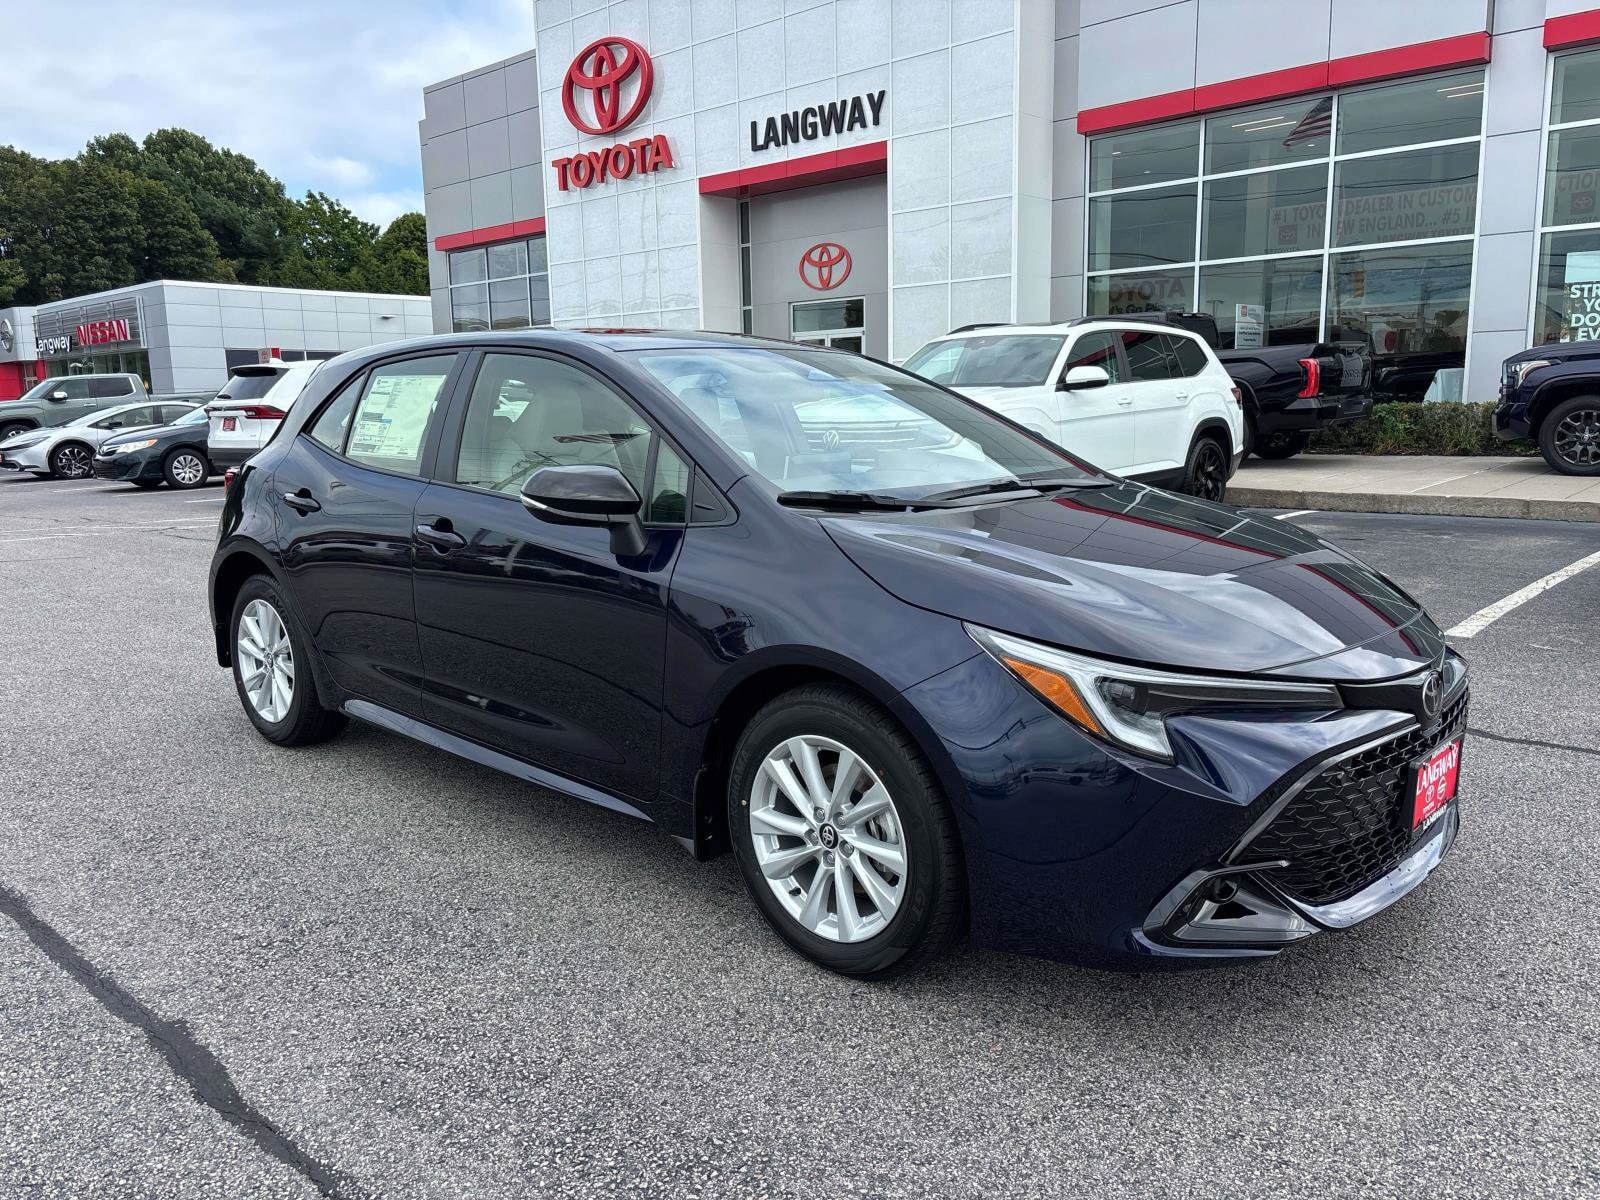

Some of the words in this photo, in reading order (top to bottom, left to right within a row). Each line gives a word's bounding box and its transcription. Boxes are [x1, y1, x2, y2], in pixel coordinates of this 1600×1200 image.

[750, 90, 886, 152] LANGWAY
[552, 135, 674, 191] TOYOTA
[1272, 208, 1287, 225] #1
[1345, 196, 1393, 216] DEALER
[1399, 193, 1413, 209] IN
[1442, 208, 1460, 226] #5
[1570, 284, 1600, 298] STR
[36, 335, 71, 354] Langway
[76, 319, 130, 346] NISSAN
[1570, 313, 1600, 328] DO
[1577, 327, 1600, 341] EV
[1416, 745, 1458, 796] LANGWAY
